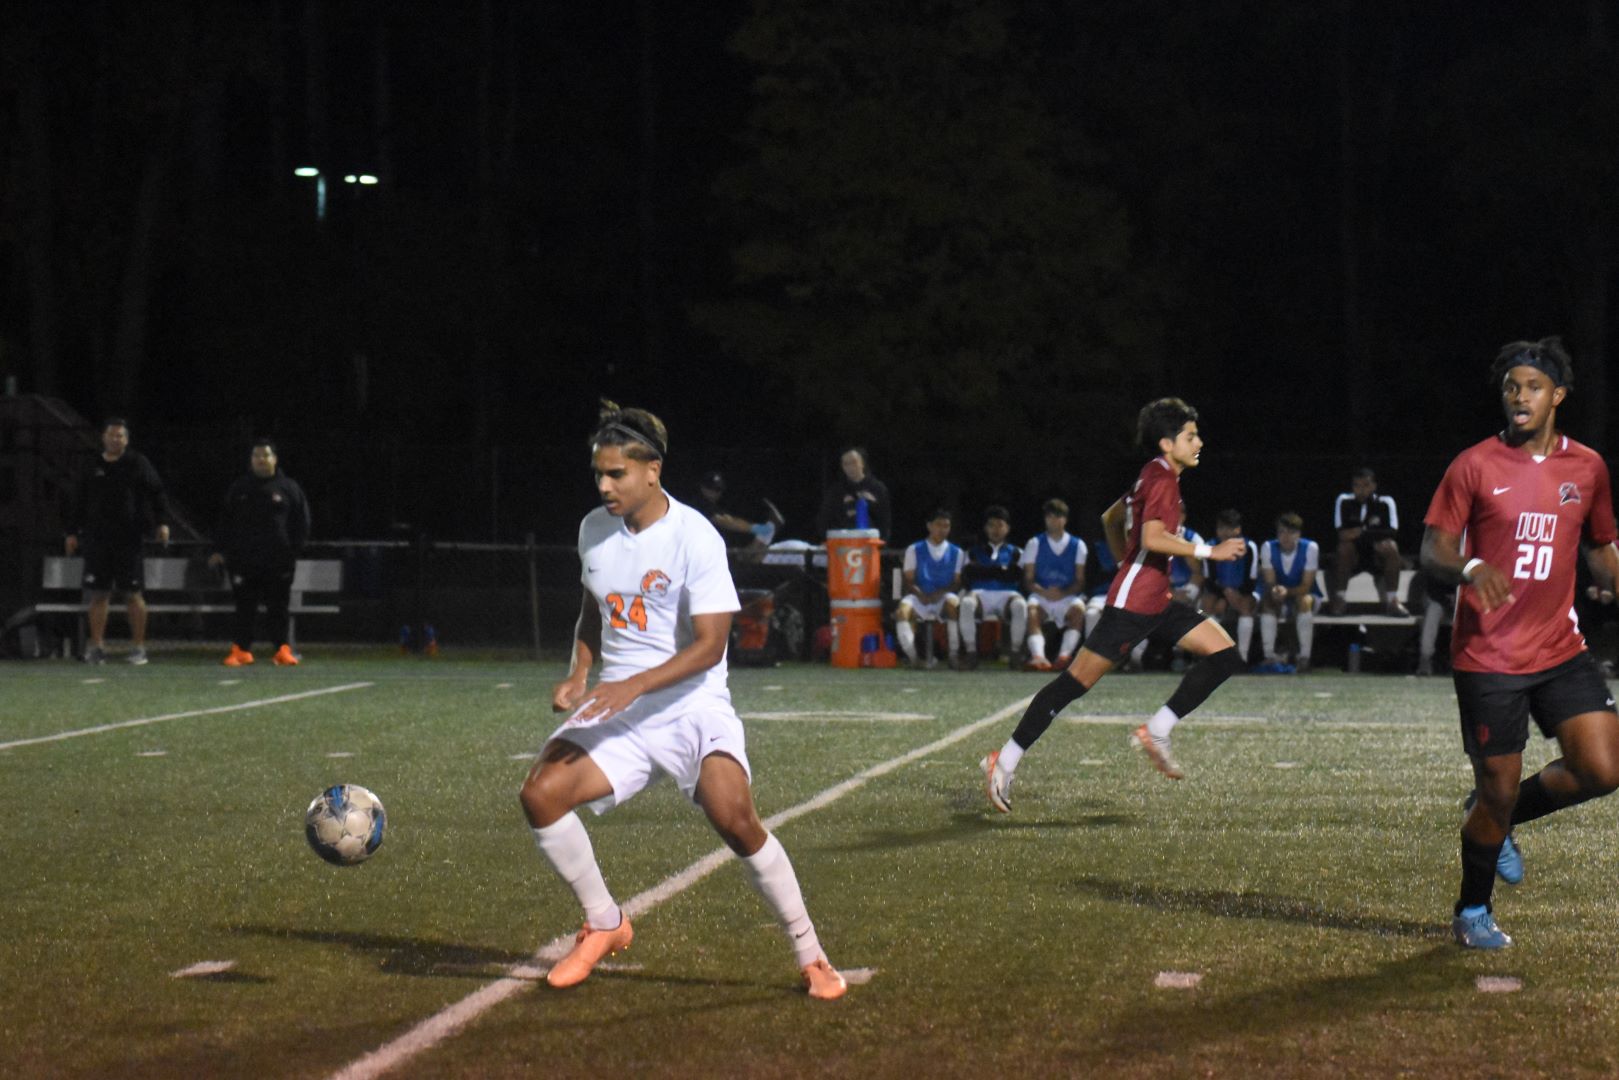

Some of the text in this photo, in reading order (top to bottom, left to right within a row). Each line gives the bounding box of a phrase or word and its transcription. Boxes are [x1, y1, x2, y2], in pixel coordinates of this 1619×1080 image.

[846, 550, 863, 567] G
[1513, 544, 1553, 580] 20
[605, 593, 648, 631] 24
